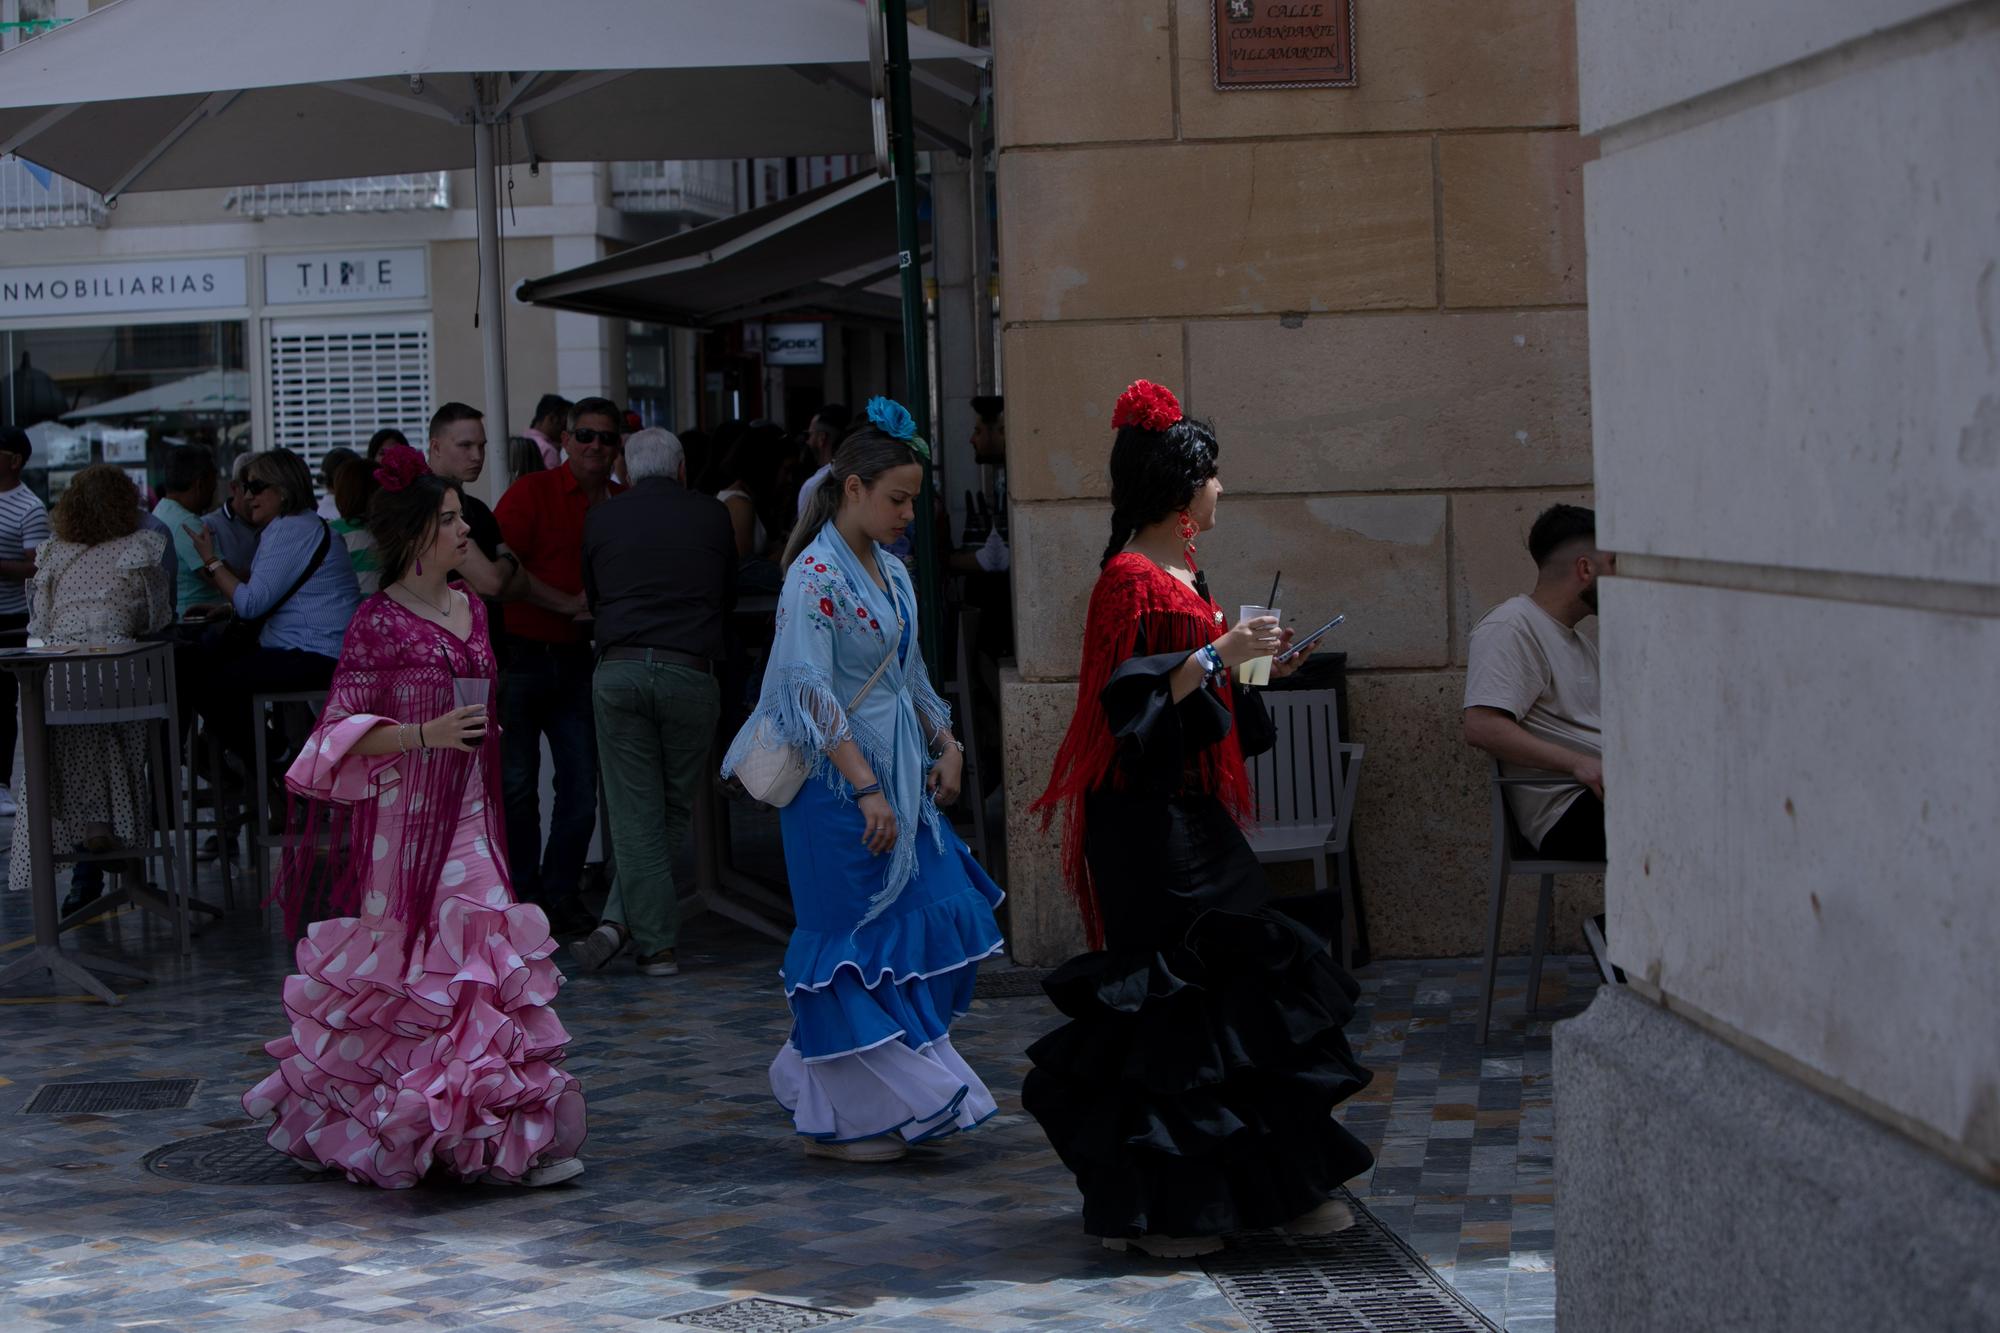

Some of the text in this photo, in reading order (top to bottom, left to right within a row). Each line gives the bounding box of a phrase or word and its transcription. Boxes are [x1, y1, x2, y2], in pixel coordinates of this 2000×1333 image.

[1267, 4, 1324, 18] CALLE
[1231, 25, 1336, 40] COMANDANTE
[4, 273, 215, 301] NMOBILIARIAS
